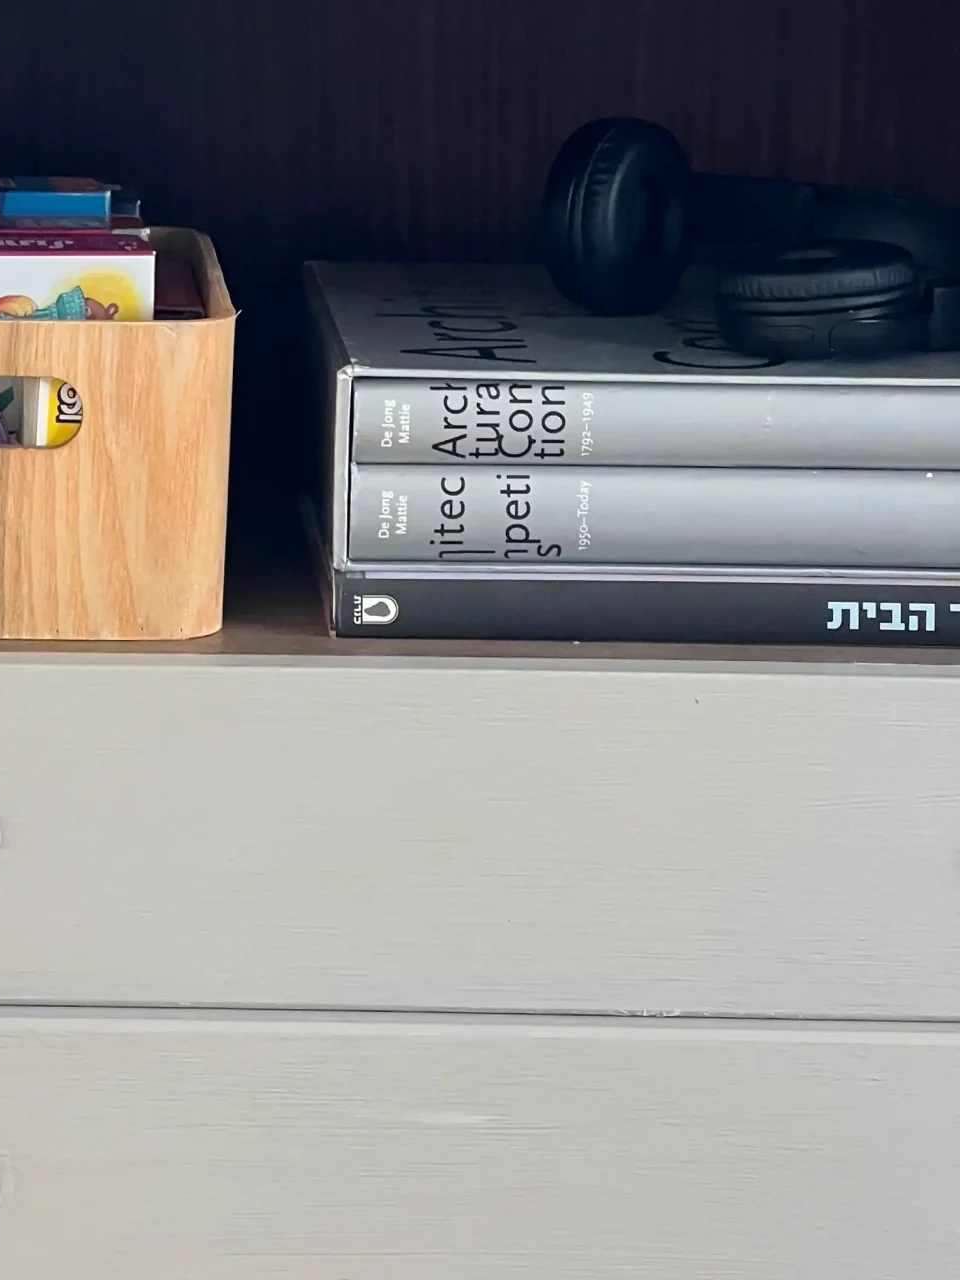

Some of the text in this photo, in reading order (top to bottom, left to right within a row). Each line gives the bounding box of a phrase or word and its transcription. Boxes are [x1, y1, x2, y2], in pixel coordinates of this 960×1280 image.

[380, 399, 397, 448] De Jong
[398, 403, 411, 443] Mattie
[534, 385, 566, 459] tion
[378, 489, 395, 540] De Jong
[395, 495, 408, 534] Mattie
[826, 601, 936, 632] הבית
